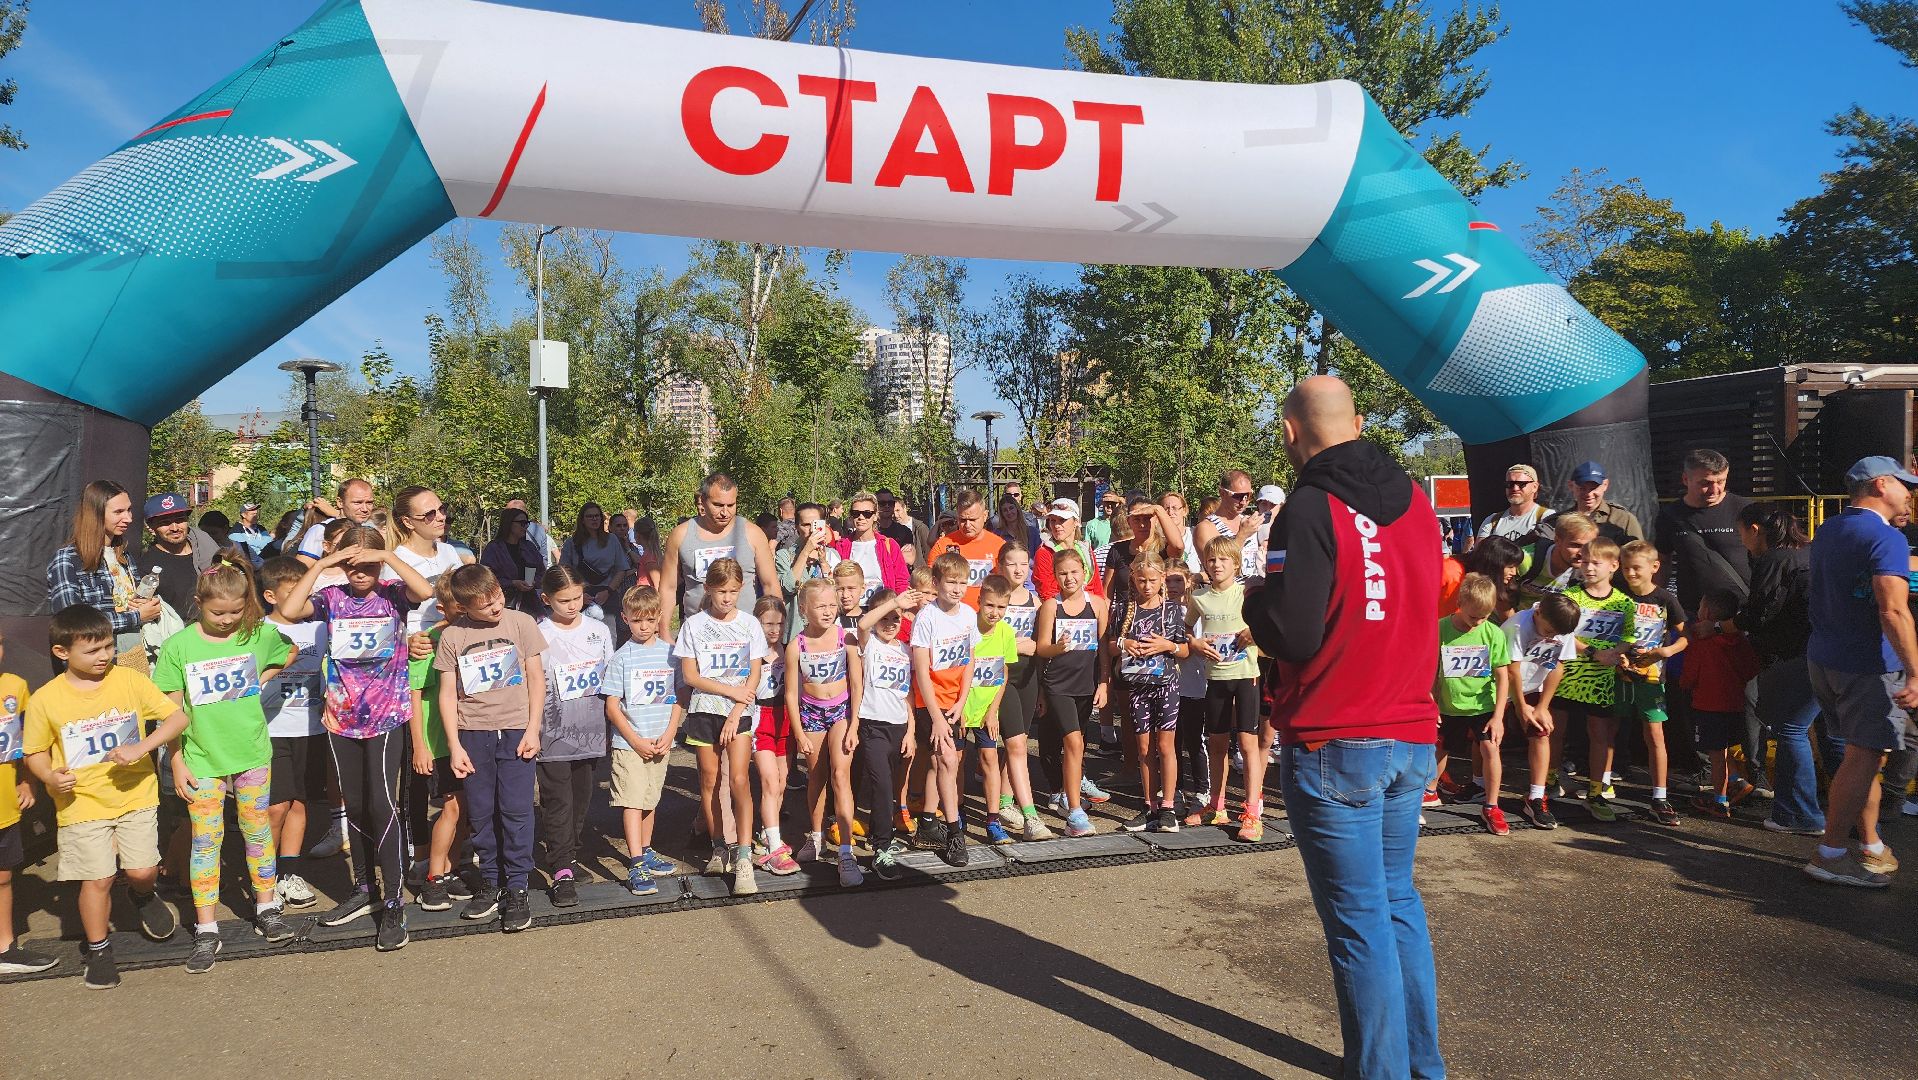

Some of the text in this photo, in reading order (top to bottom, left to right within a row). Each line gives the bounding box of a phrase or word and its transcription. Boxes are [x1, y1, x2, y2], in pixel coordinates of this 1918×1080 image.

[681, 66, 1145, 202] СТАРТ
[1345, 505, 1387, 621] РЕУТО
[1583, 618, 1618, 634] 237
[349, 632, 378, 650] 33
[710, 653, 741, 670] 112
[938, 645, 966, 663] 262
[478, 661, 503, 683] 13
[809, 661, 839, 678] 157
[1450, 656, 1483, 671] 272
[199, 669, 247, 695] 183
[564, 671, 600, 692] 268
[880, 665, 906, 684] 250
[280, 682, 305, 700] 51
[643, 680, 666, 697] 95
[85, 732, 119, 756] 10
